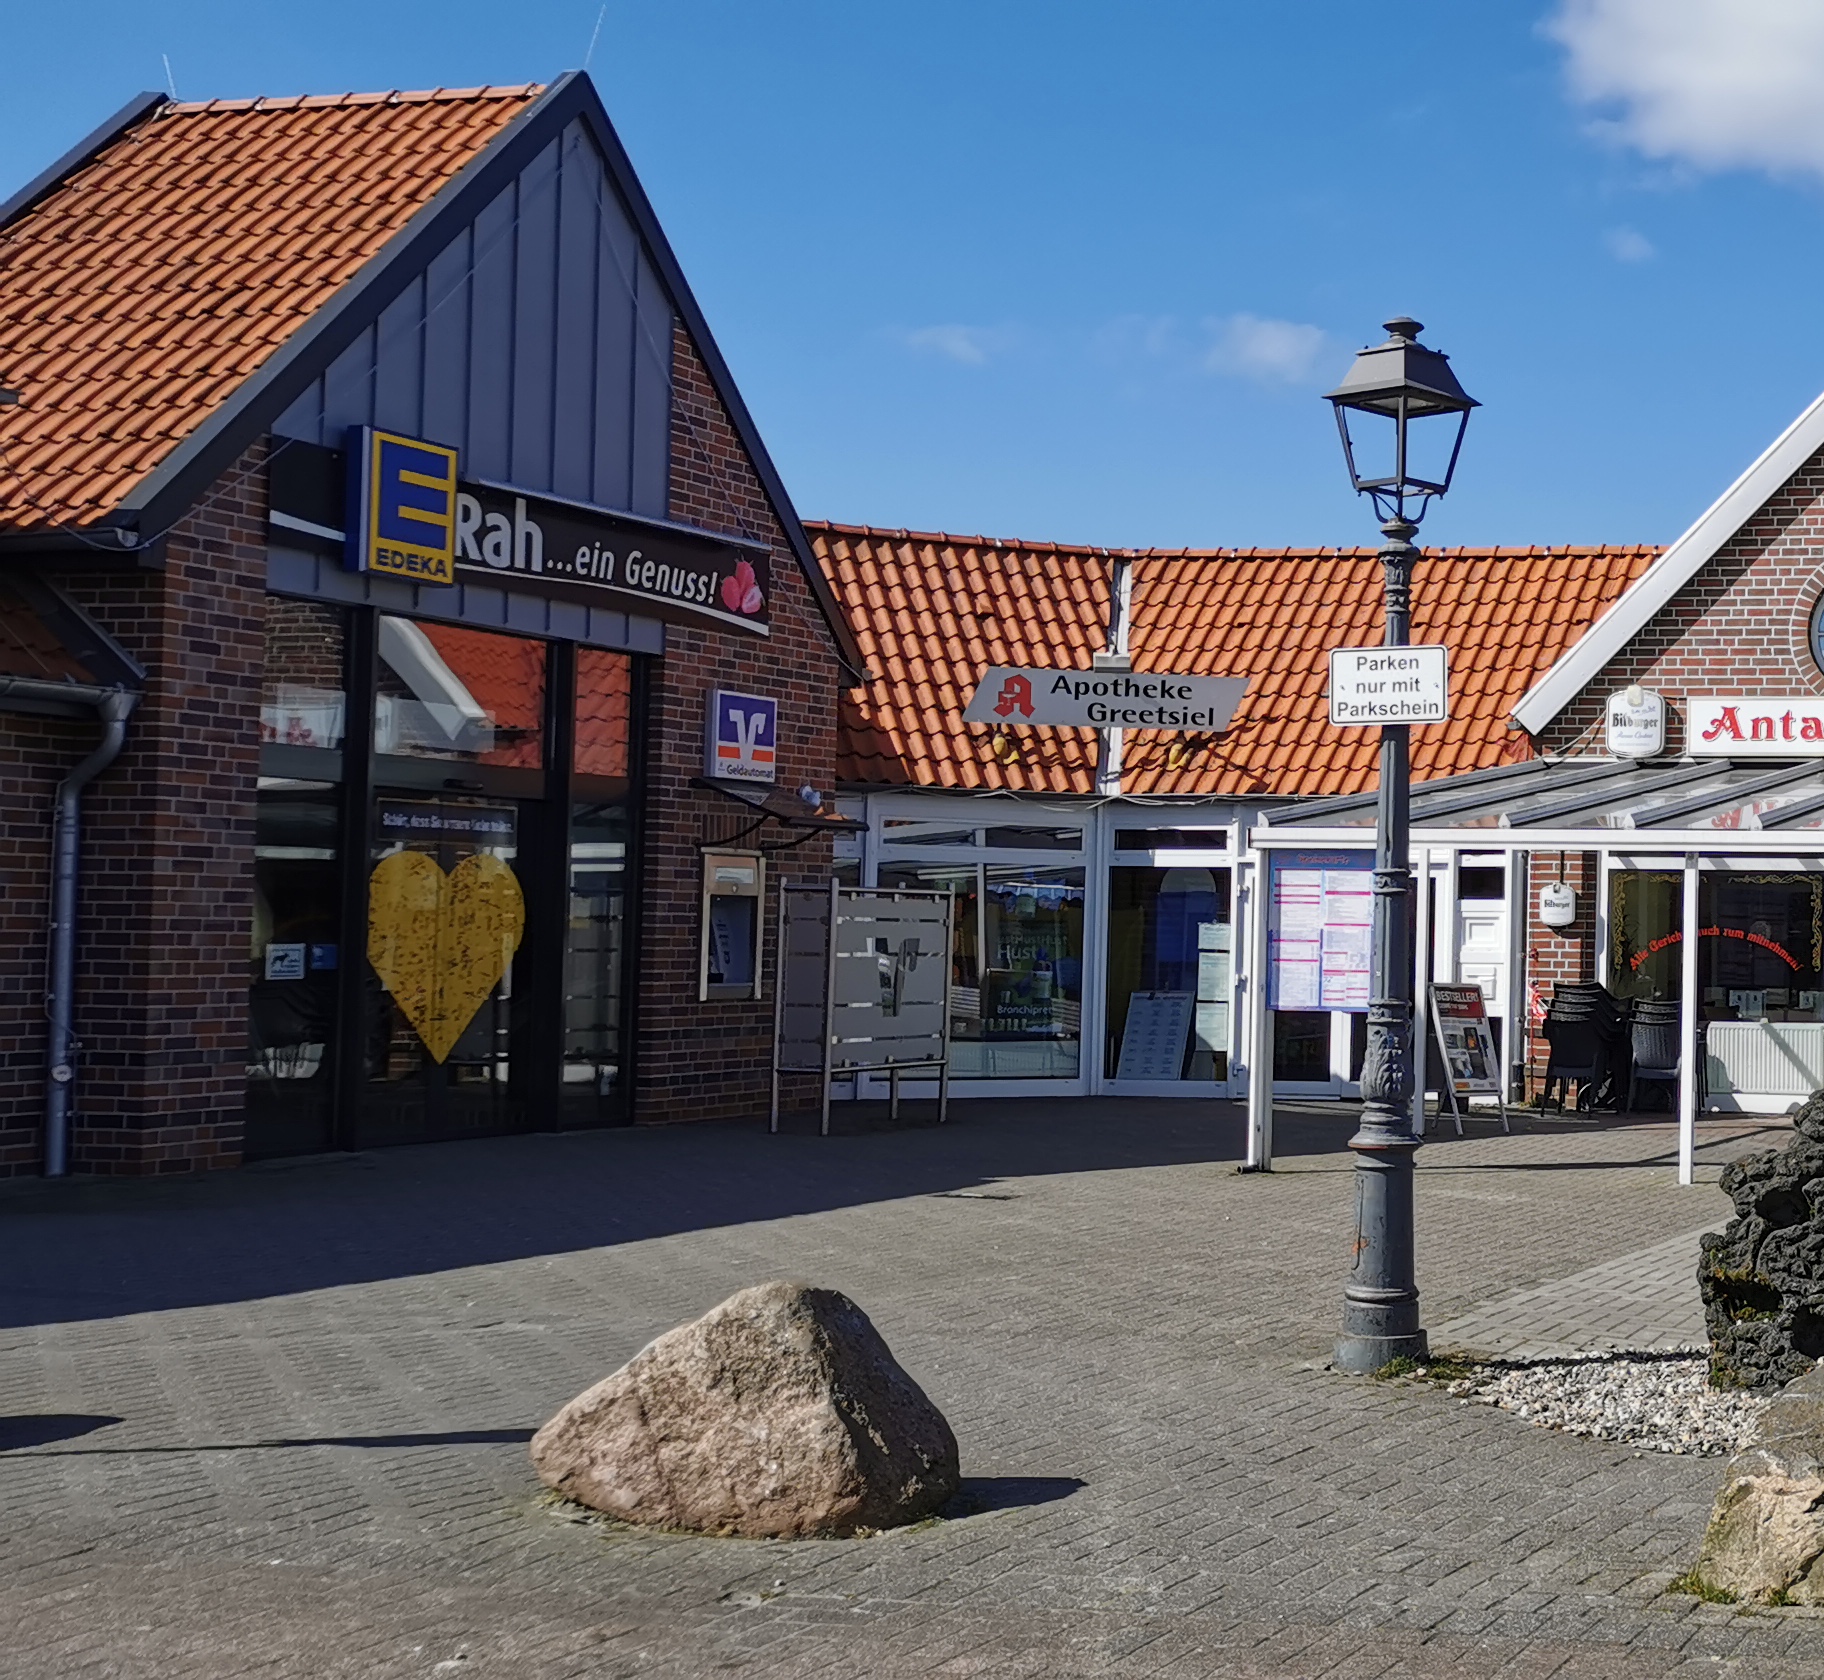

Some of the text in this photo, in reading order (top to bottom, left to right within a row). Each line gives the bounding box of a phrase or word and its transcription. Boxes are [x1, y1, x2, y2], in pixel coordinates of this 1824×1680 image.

[375, 547, 449, 579] EDEKA
[625, 549, 718, 604] Genuss!
[1356, 655, 1420, 671] Parken
[1050, 674, 1193, 701] Apotheke
[1356, 676, 1421, 694] nur mit
[1087, 702, 1215, 727] Greetsiel
[1337, 699, 1439, 717] Parkschein
[726, 764, 774, 779] Geldautomat
[1648, 930, 1683, 953] Gerich
[1698, 925, 1721, 937] uch
[1722, 927, 1744, 939] zum
